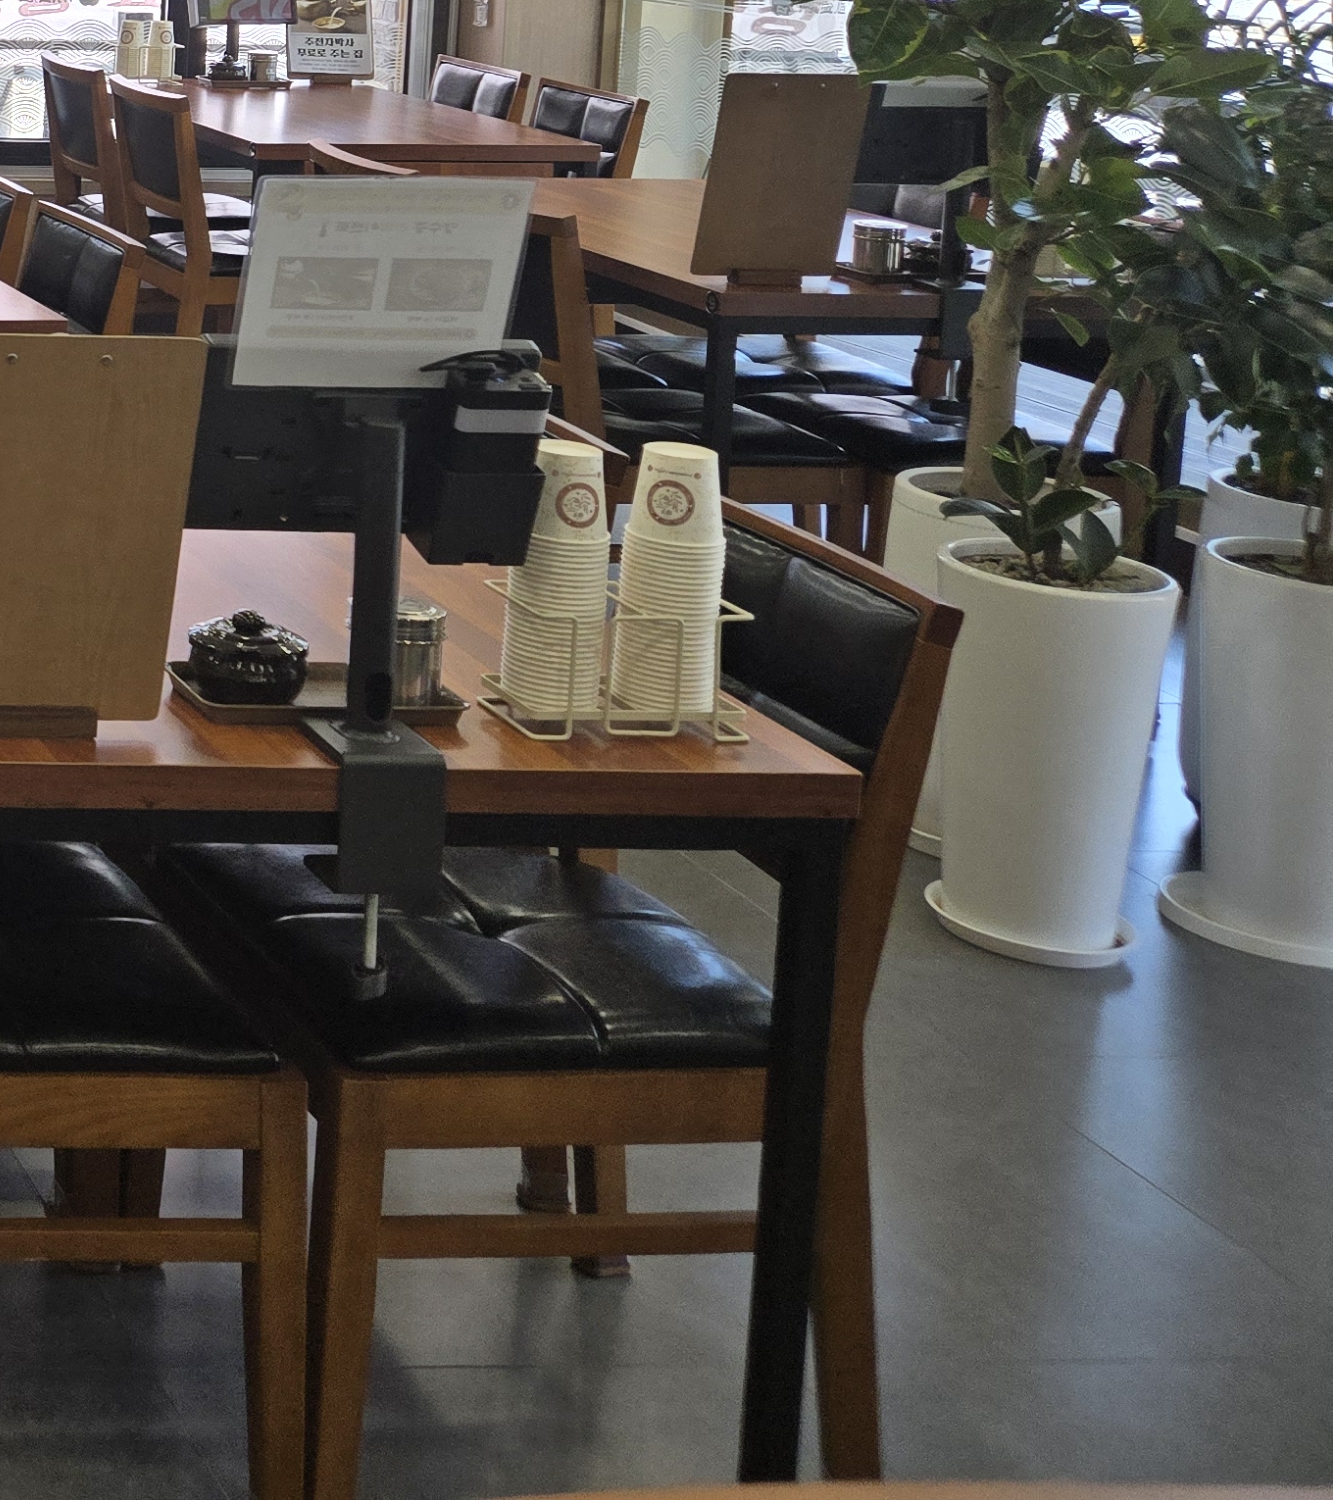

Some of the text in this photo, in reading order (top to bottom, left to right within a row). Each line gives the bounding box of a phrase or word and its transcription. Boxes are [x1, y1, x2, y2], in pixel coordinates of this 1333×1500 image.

[297, 47, 363, 59] 무료로 주는 집
